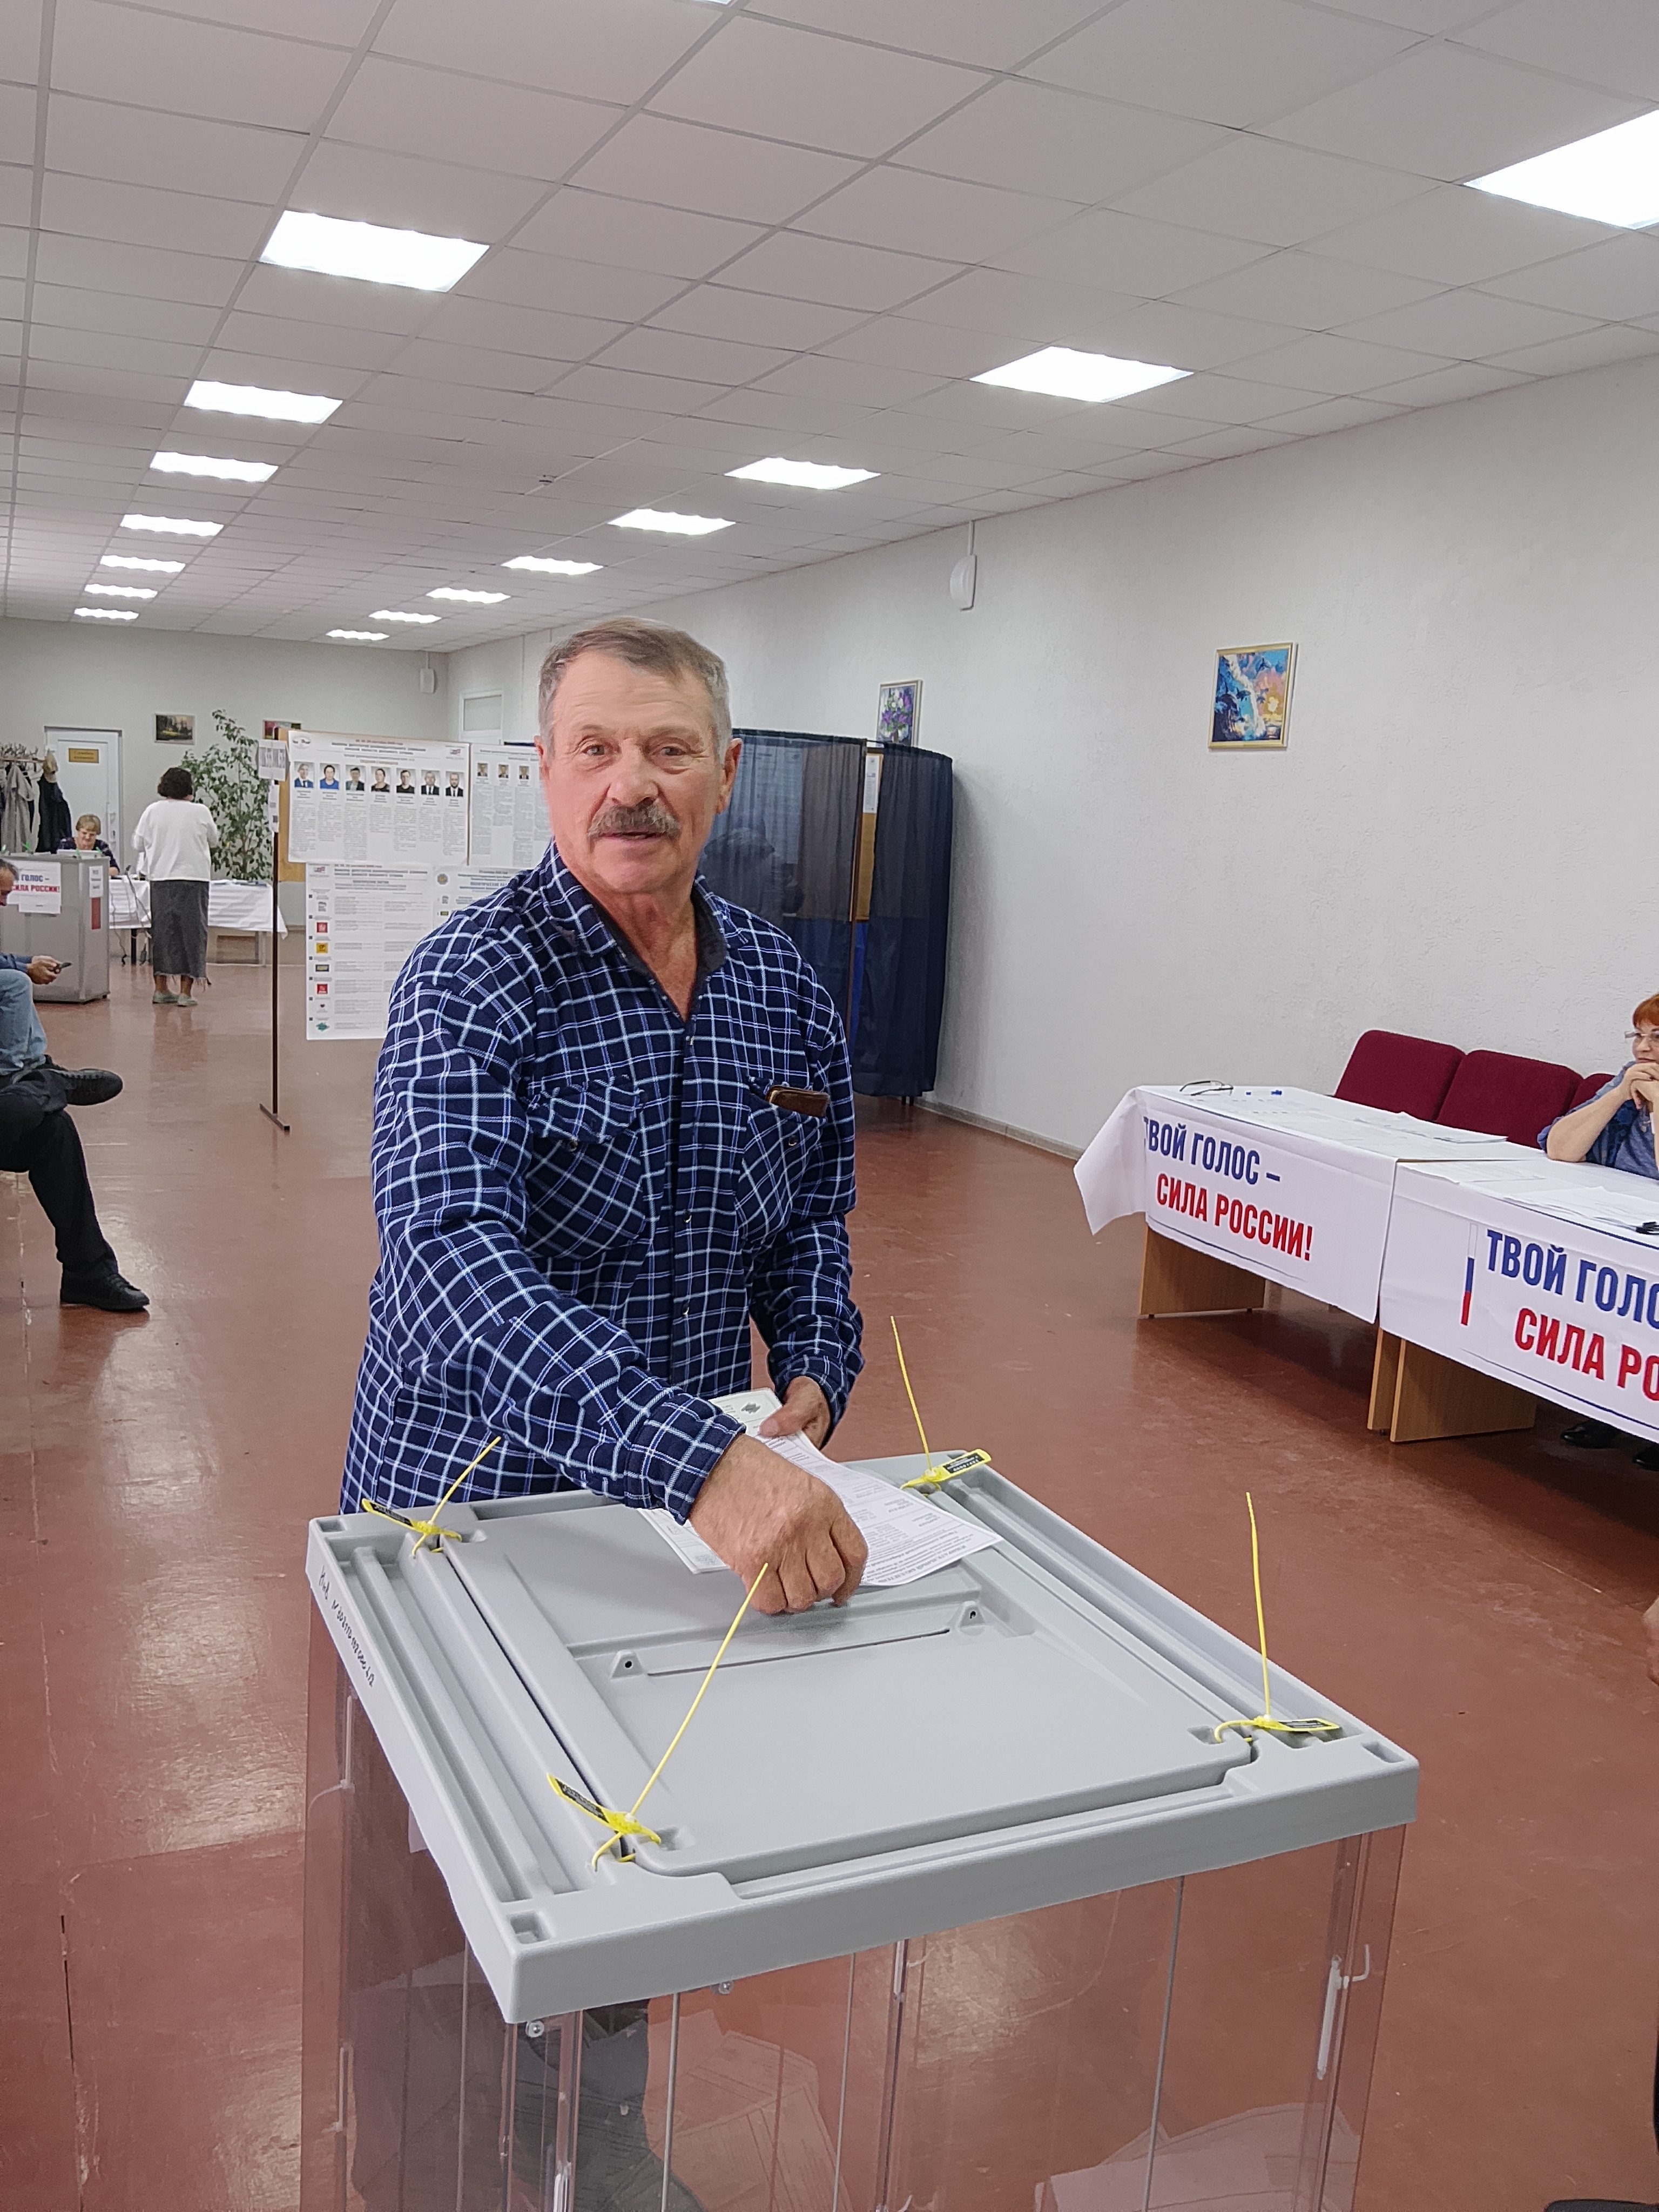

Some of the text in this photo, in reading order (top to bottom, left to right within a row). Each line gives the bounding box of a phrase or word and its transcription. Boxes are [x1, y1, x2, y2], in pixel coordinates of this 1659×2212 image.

[1191, 1132, 1260, 1185] ГОЛОС
[1157, 1173, 1312, 1261] СИЛА РОССИИ!
[1487, 1229, 1567, 1296] ТВОЙ
[1515, 1307, 1604, 1380] СИЛА
